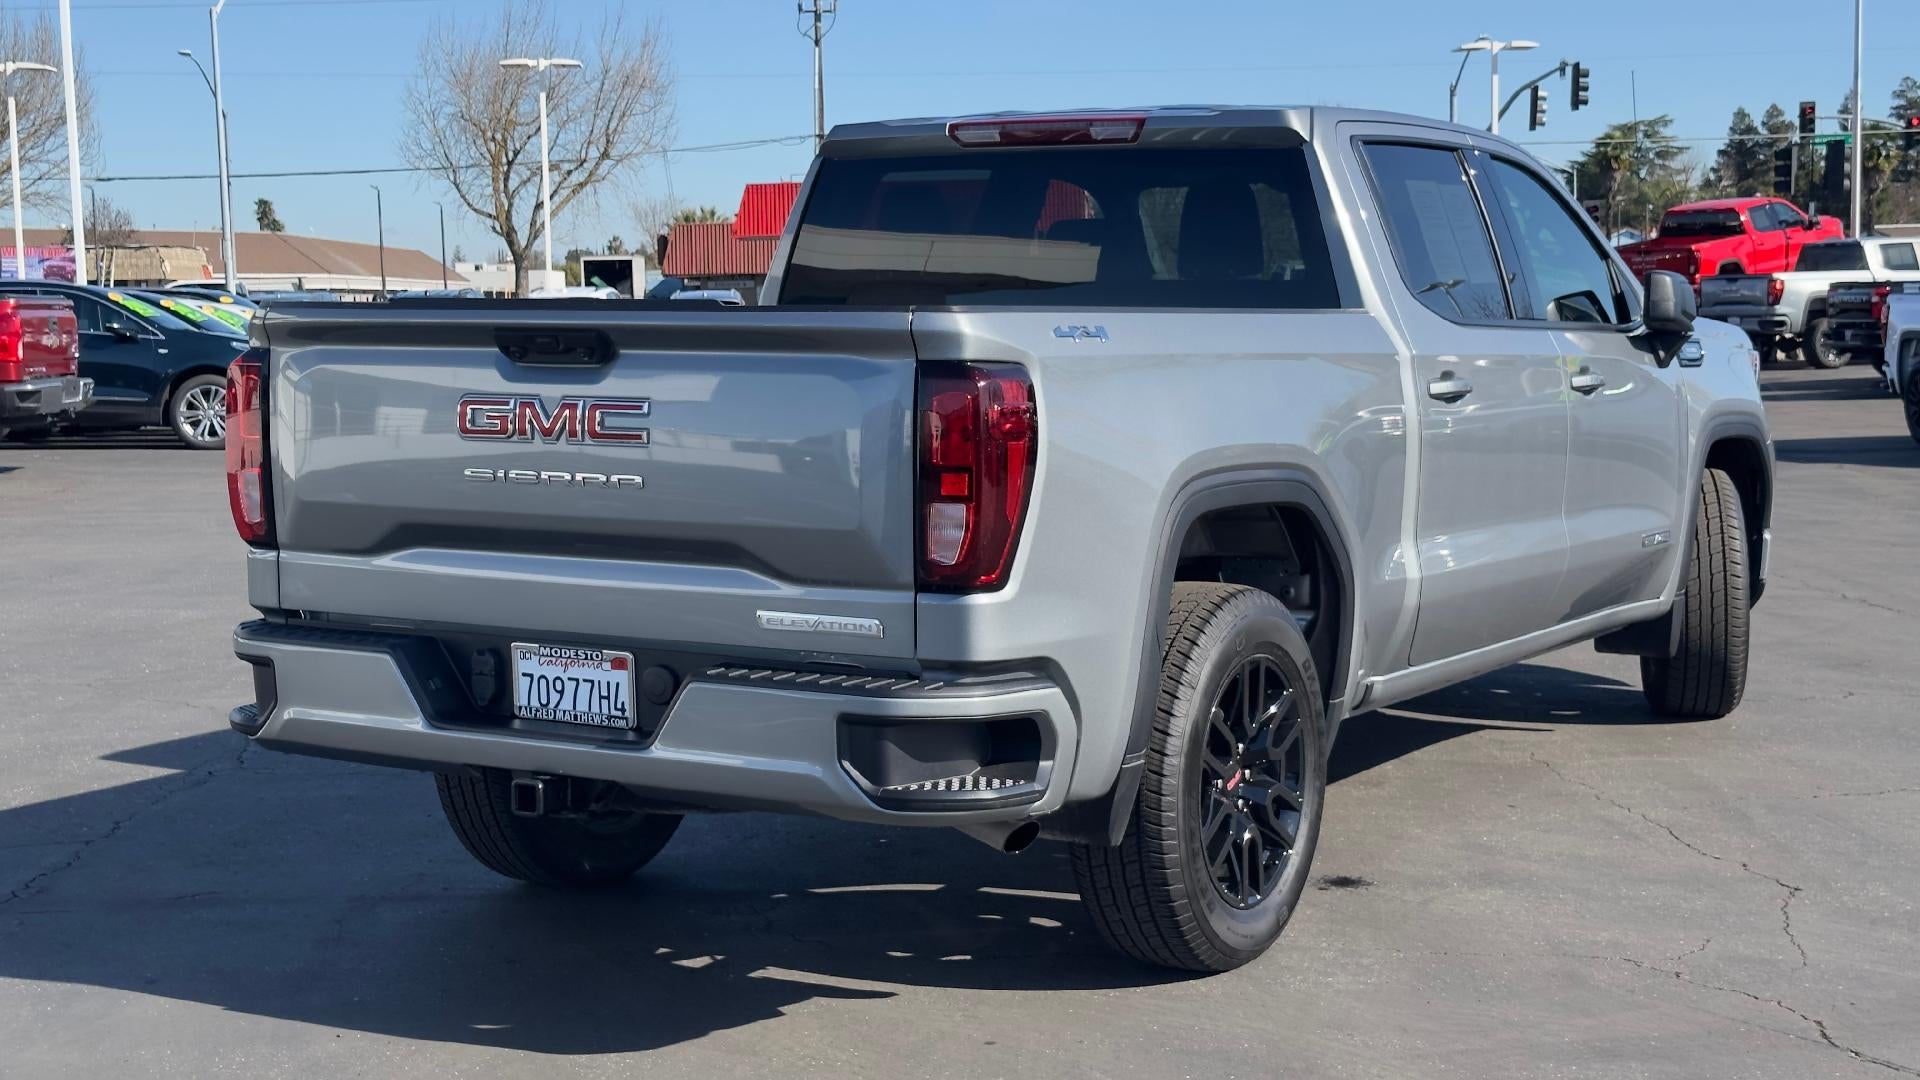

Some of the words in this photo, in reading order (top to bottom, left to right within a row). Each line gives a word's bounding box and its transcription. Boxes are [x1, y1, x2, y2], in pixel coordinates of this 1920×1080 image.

[456, 394, 651, 446] GMC
[463, 467, 645, 489] SIERRA
[764, 614, 874, 633] ELEVATION
[540, 646, 602, 661] MODESTO
[521, 672, 627, 716] 70977H4
[520, 706, 554, 720] ALFRED
[555, 710, 628, 728] MATTHEWS.COM
